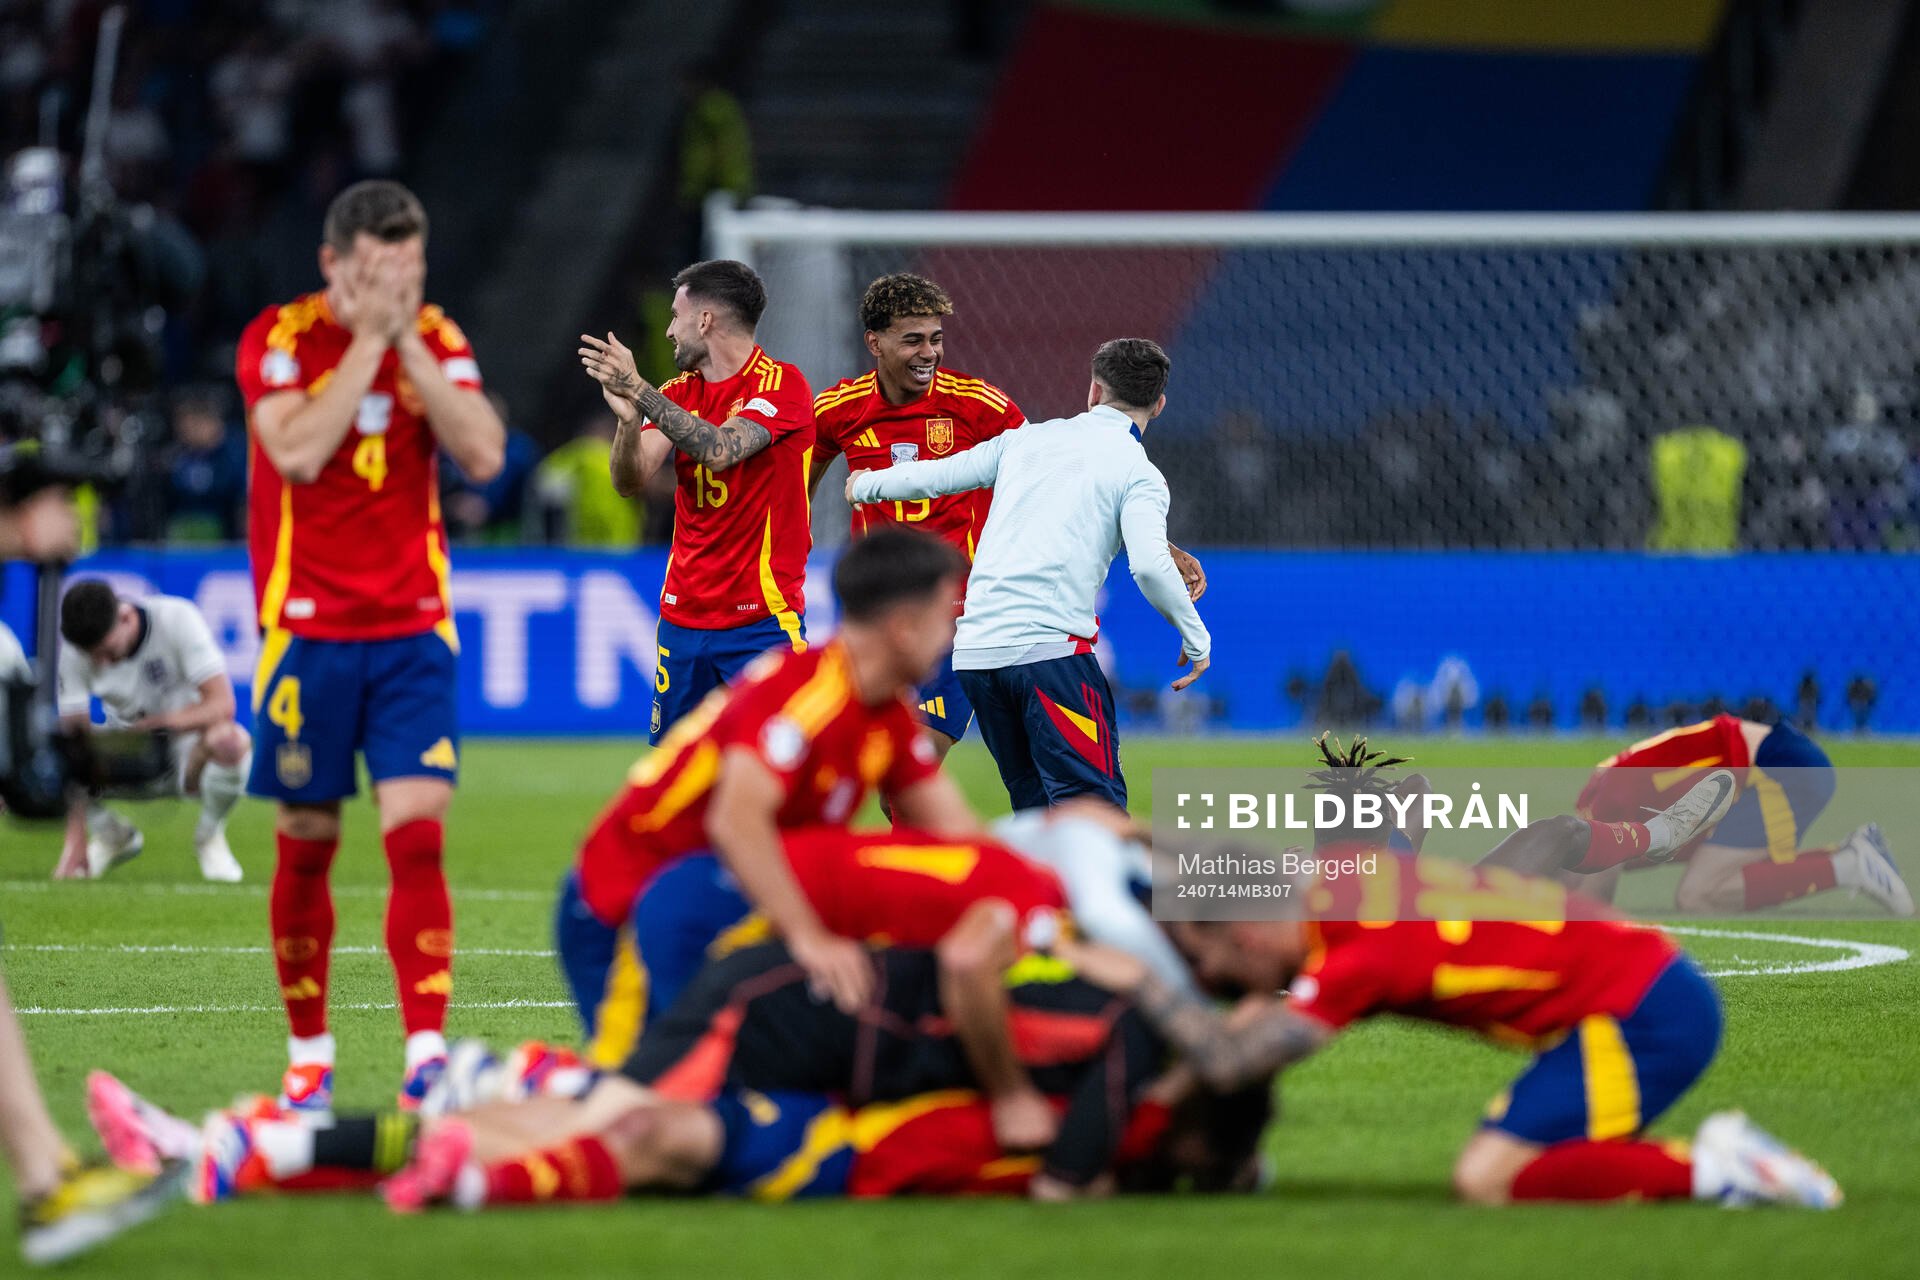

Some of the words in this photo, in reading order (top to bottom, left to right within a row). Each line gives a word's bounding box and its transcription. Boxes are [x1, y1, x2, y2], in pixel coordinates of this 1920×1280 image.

[353, 435, 388, 491] 4
[694, 463, 728, 508] 15
[268, 675, 304, 738] 4
